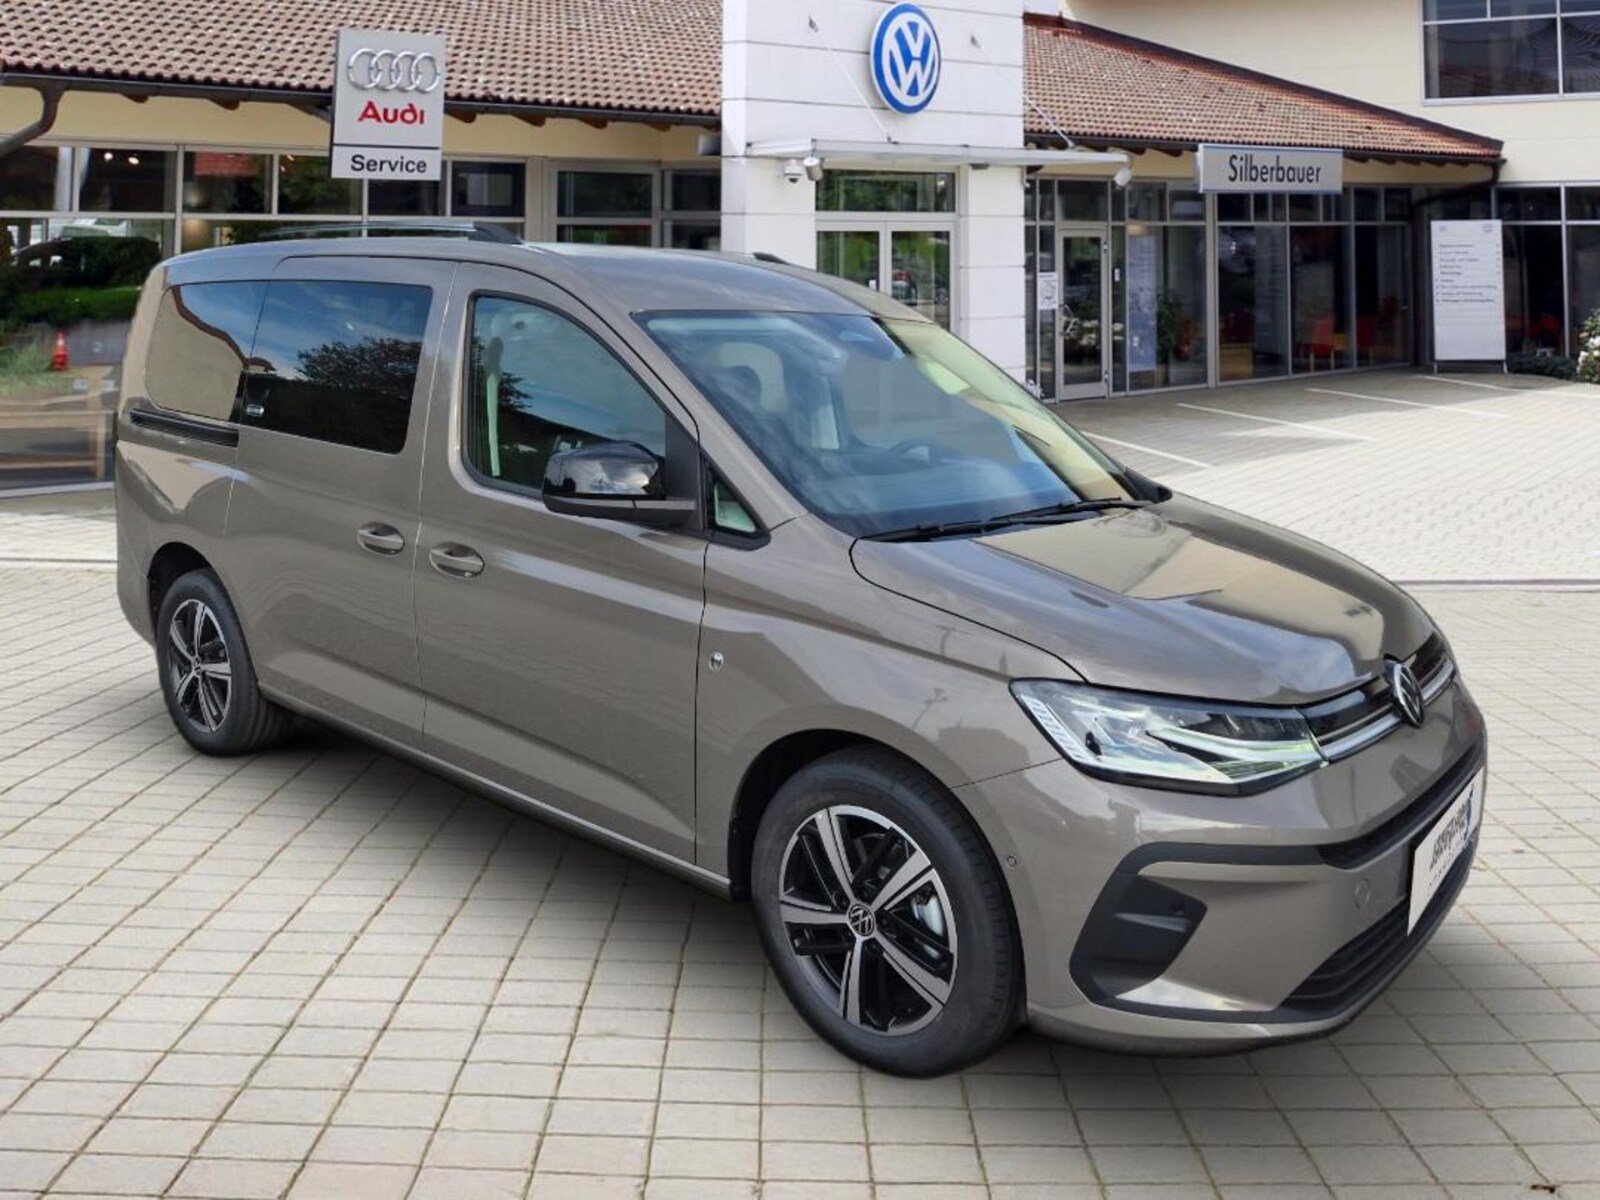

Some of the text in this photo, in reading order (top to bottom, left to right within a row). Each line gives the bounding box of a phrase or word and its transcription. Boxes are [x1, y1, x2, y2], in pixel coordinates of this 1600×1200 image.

[358, 100, 425, 125] Audi
[350, 154, 427, 173] Service
[1228, 154, 1321, 183] Silberbauer
